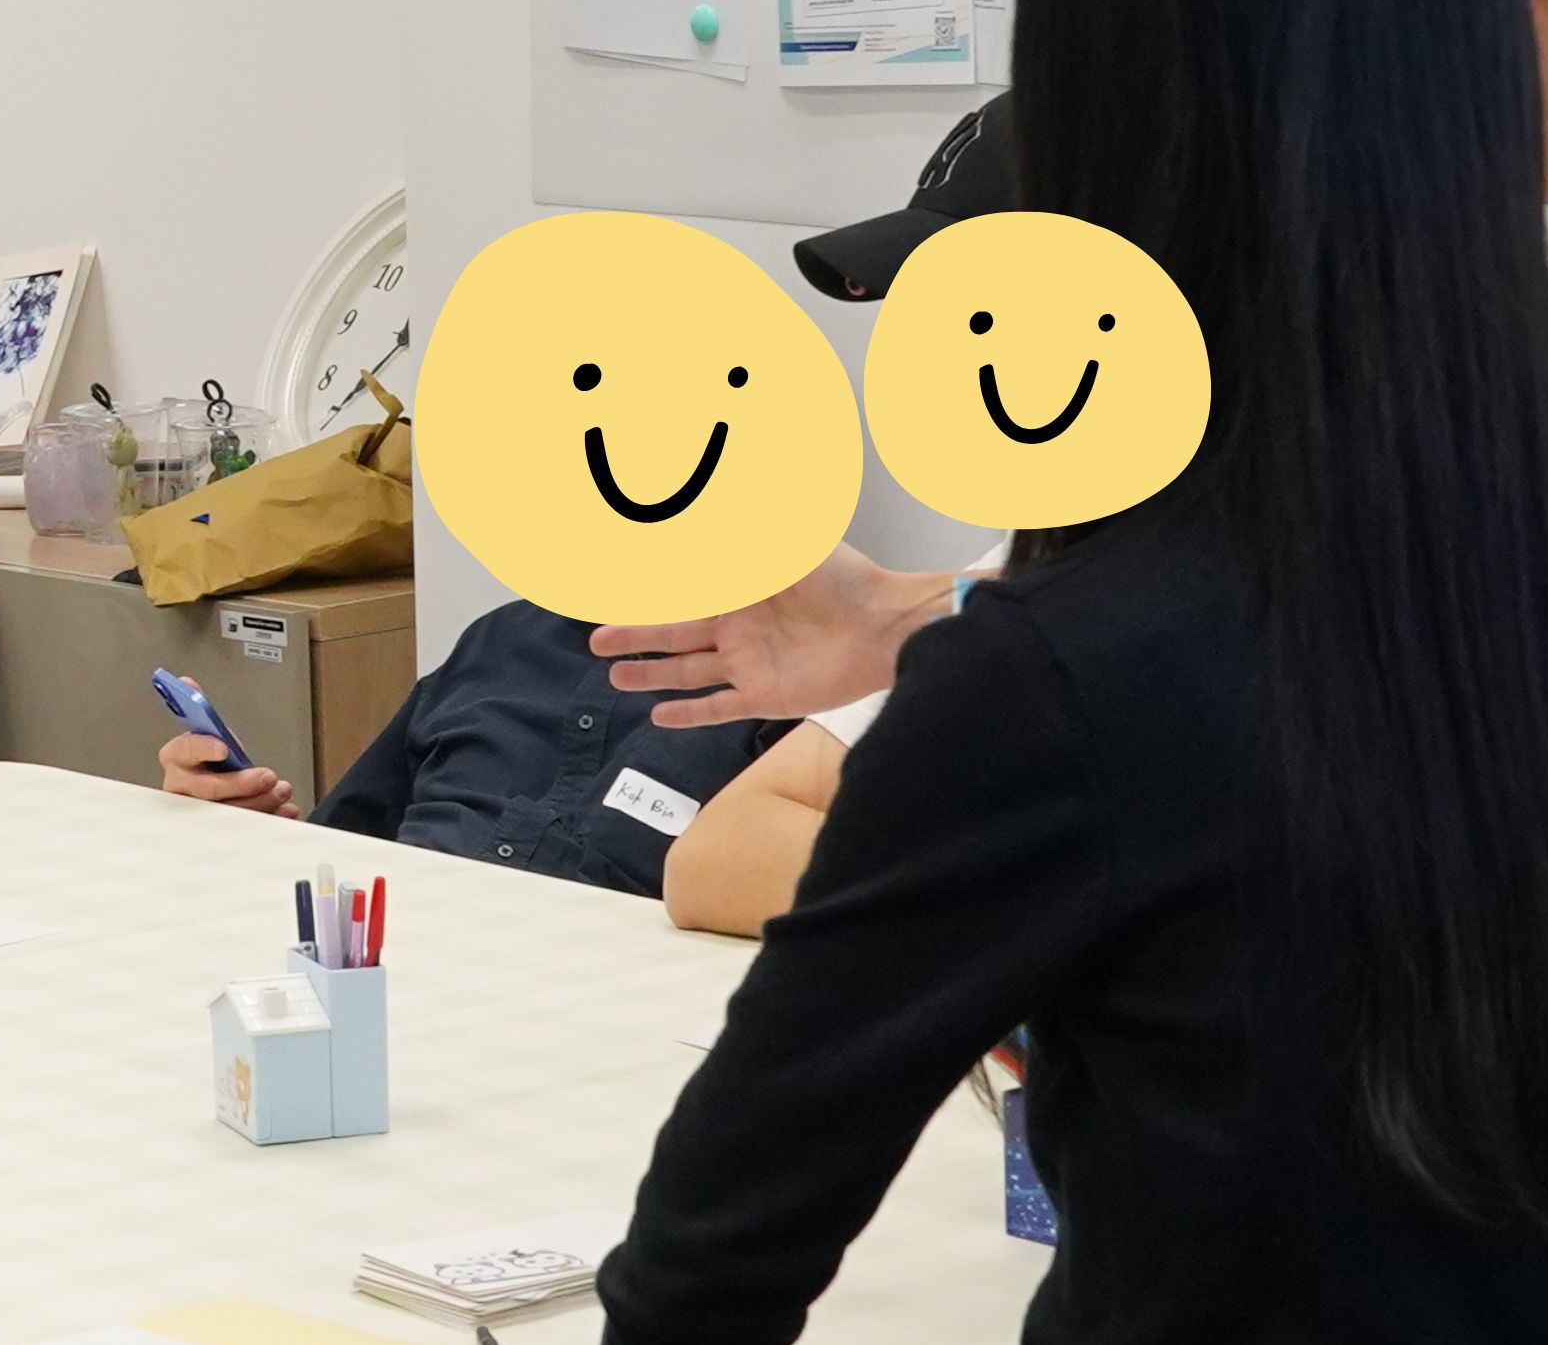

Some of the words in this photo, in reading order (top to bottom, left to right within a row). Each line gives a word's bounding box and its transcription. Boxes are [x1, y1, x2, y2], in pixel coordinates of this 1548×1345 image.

[372, 263, 404, 292] 10
[337, 309, 358, 335] 9
[317, 364, 338, 391] 8
[650, 799, 675, 819] Bin
